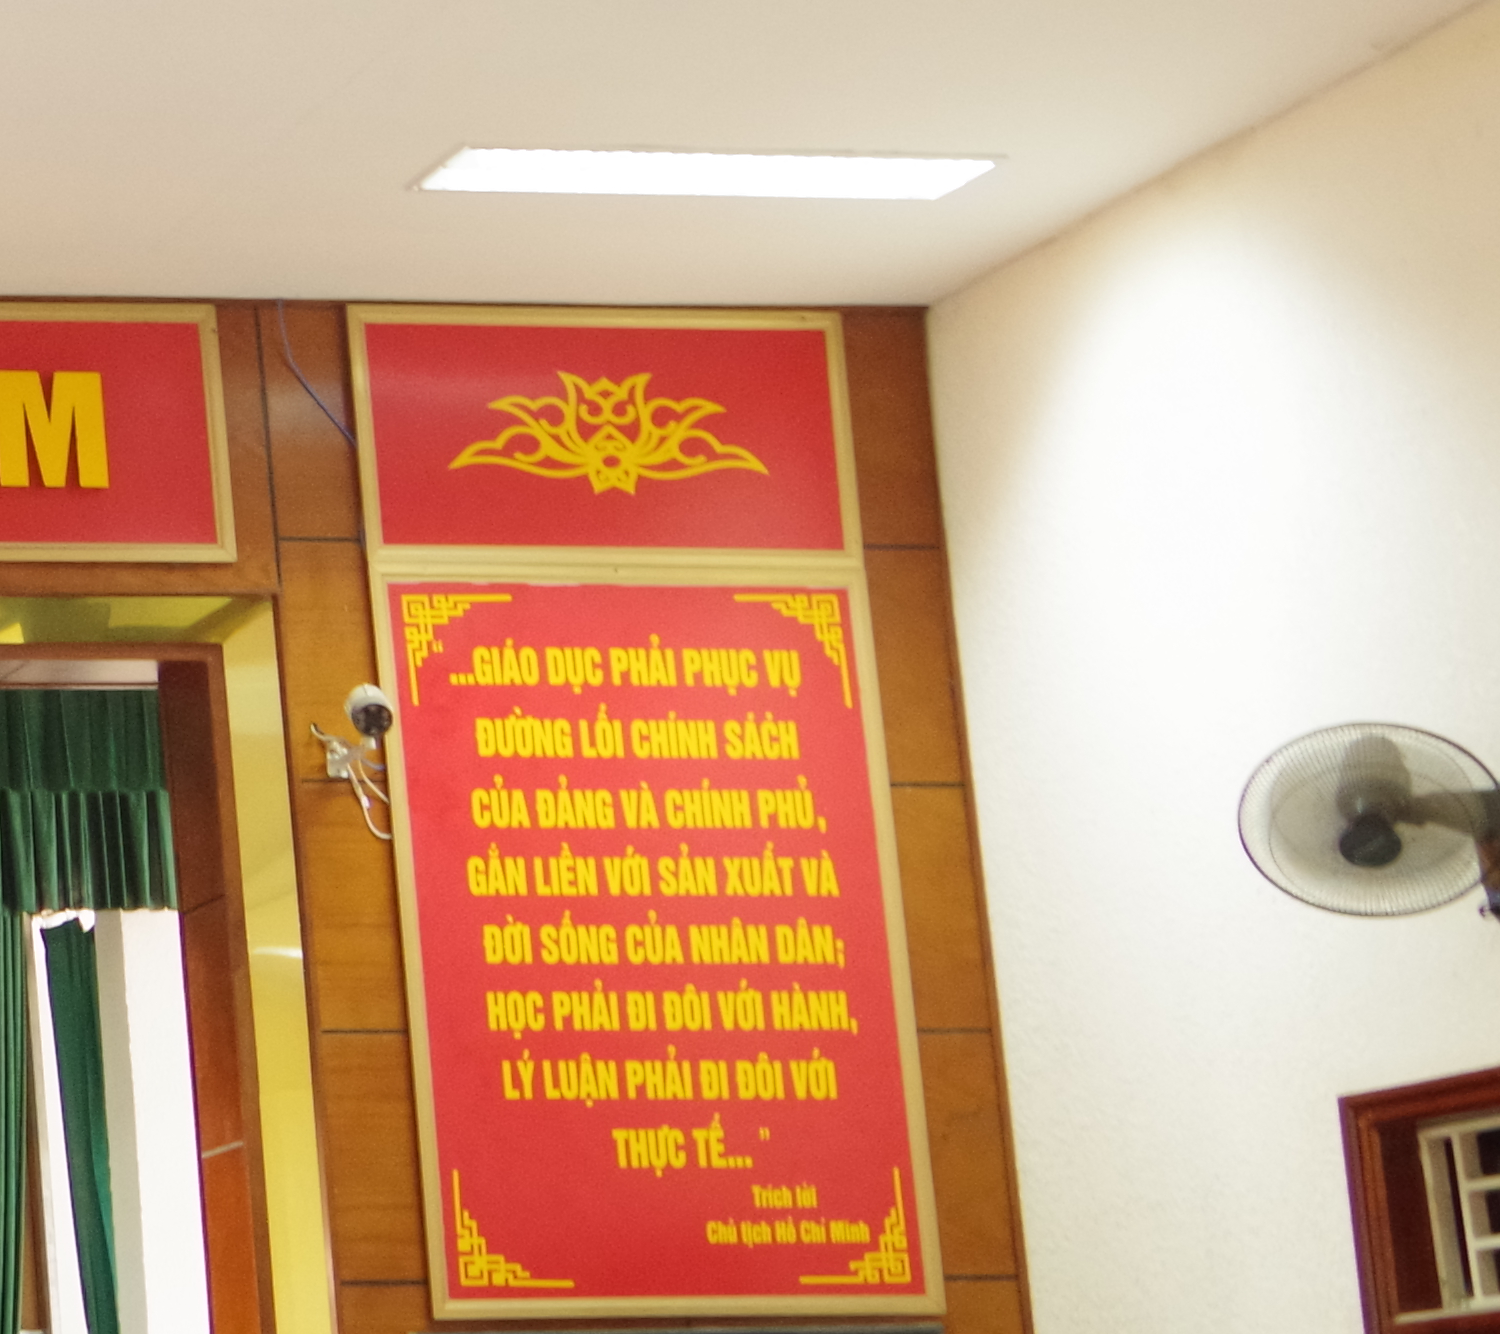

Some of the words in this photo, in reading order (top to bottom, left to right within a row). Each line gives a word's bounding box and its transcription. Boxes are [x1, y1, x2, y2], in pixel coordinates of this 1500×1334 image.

[545, 647, 604, 694] DỤC
[609, 634, 678, 687] PHẢI
[681, 648, 760, 696] PHỤC
[762, 649, 802, 697] VỤ
[475, 707, 574, 758] ĐƯỜNG
[630, 711, 719, 759] CHÍNH
[471, 775, 531, 828] CỦA
[535, 775, 616, 829] ĐẢNG
[619, 781, 660, 829] VÀ
[664, 778, 753, 829] CHÍNH
[533, 842, 598, 896] LIỀN
[602, 845, 652, 896] VỚI
[657, 843, 718, 896] SẢN
[722, 841, 795, 897] XUẤT
[799, 850, 840, 897] VÀ
[483, 915, 533, 964] ĐỜI
[539, 910, 619, 964] SỐNG
[625, 910, 685, 965] CỦA
[688, 917, 770, 964] NHÂN
[486, 991, 545, 1039] HỌC
[552, 980, 620, 1030] PHẢI
[626, 991, 657, 1031] ĐI
[662, 984, 712, 1031] ĐÔI
[716, 979, 765, 1031] VỚI
[770, 983, 858, 1033] HÀNH,
[502, 1050, 534, 1099] LÝ
[542, 1053, 619, 1107] LUẬN
[625, 1045, 693, 1099] PHẢI
[699, 1060, 730, 1100] ĐI
[735, 1052, 785, 1100] ĐÔI
[789, 1048, 837, 1100] VỚI
[612, 1125, 686, 1176] THỰC
